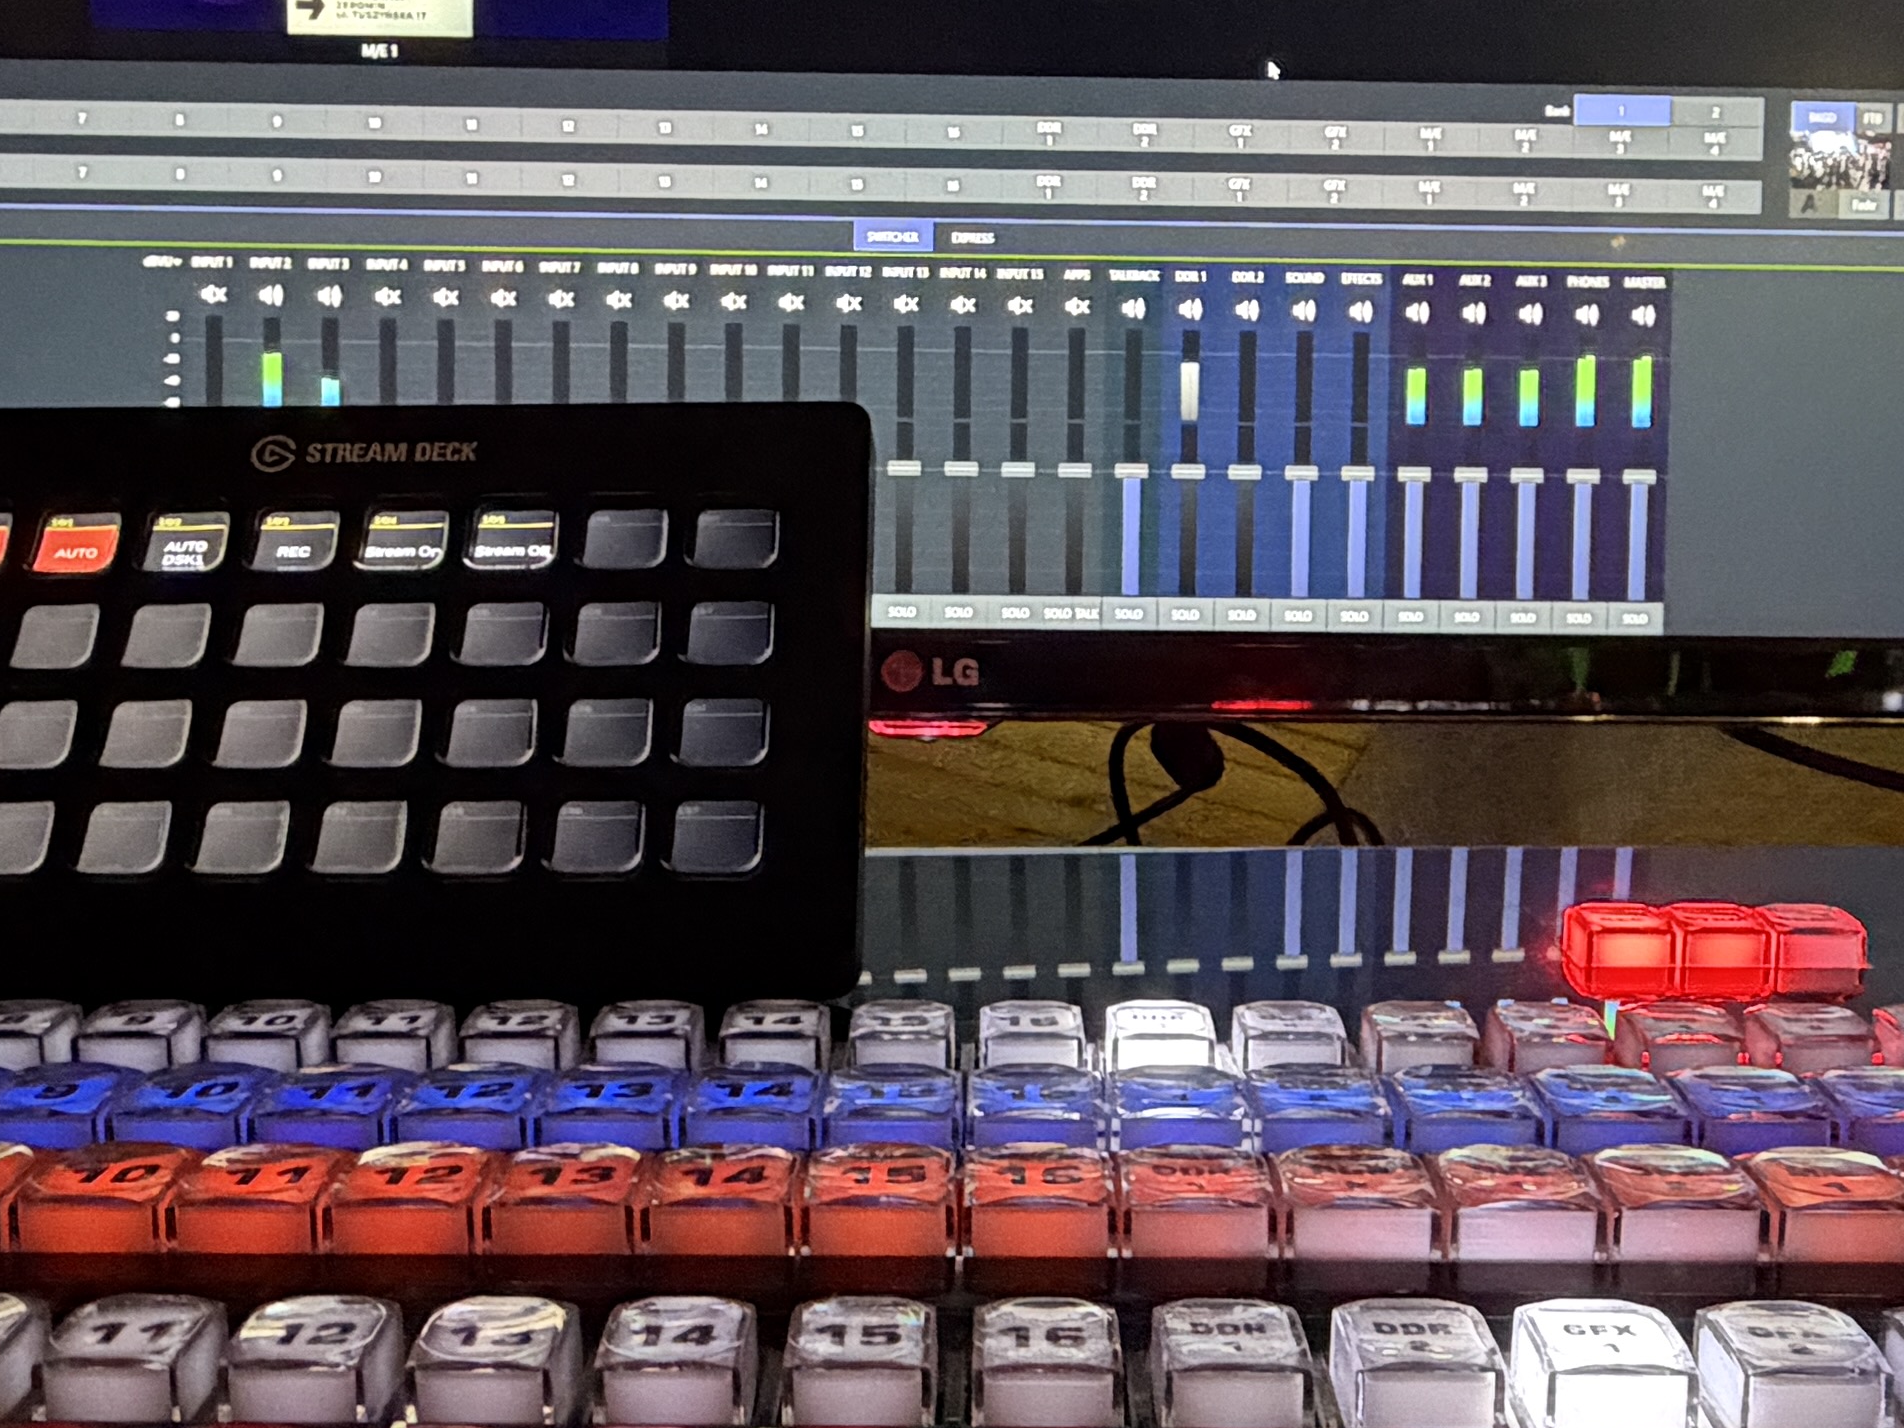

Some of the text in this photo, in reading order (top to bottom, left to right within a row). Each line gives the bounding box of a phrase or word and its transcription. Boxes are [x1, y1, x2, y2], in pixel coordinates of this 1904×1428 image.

[306, 441, 478, 463] STREAM DECK
[54, 548, 98, 559] AUTO
[163, 540, 208, 553] AUTO
[276, 546, 311, 558] REC
[365, 545, 416, 558] Stream
[474, 545, 525, 557] Stream
[888, 606, 917, 619] SOLO
[945, 606, 974, 620] SOLO
[1044, 607, 1072, 620] SOLO
[1114, 608, 1144, 621] SOLO
[1228, 609, 1257, 622] SOLO
[1284, 610, 1313, 623] SOLO
[1340, 610, 1370, 623] SOLO
[1510, 612, 1537, 624] SOLO
[932, 658, 980, 686] LG
[239, 1013, 298, 1026] 10
[70, 1163, 164, 1185] 10
[222, 1165, 313, 1186] 11
[371, 1163, 467, 1186] 12
[526, 1164, 621, 1186] 13
[679, 1164, 772, 1186] 14
[92, 1321, 182, 1345] 11
[275, 1322, 359, 1346] 12
[639, 1323, 718, 1347] 14
[815, 1323, 903, 1347] 15
[999, 1325, 1085, 1348] 16
[1562, 1321, 1639, 1338] GFX
